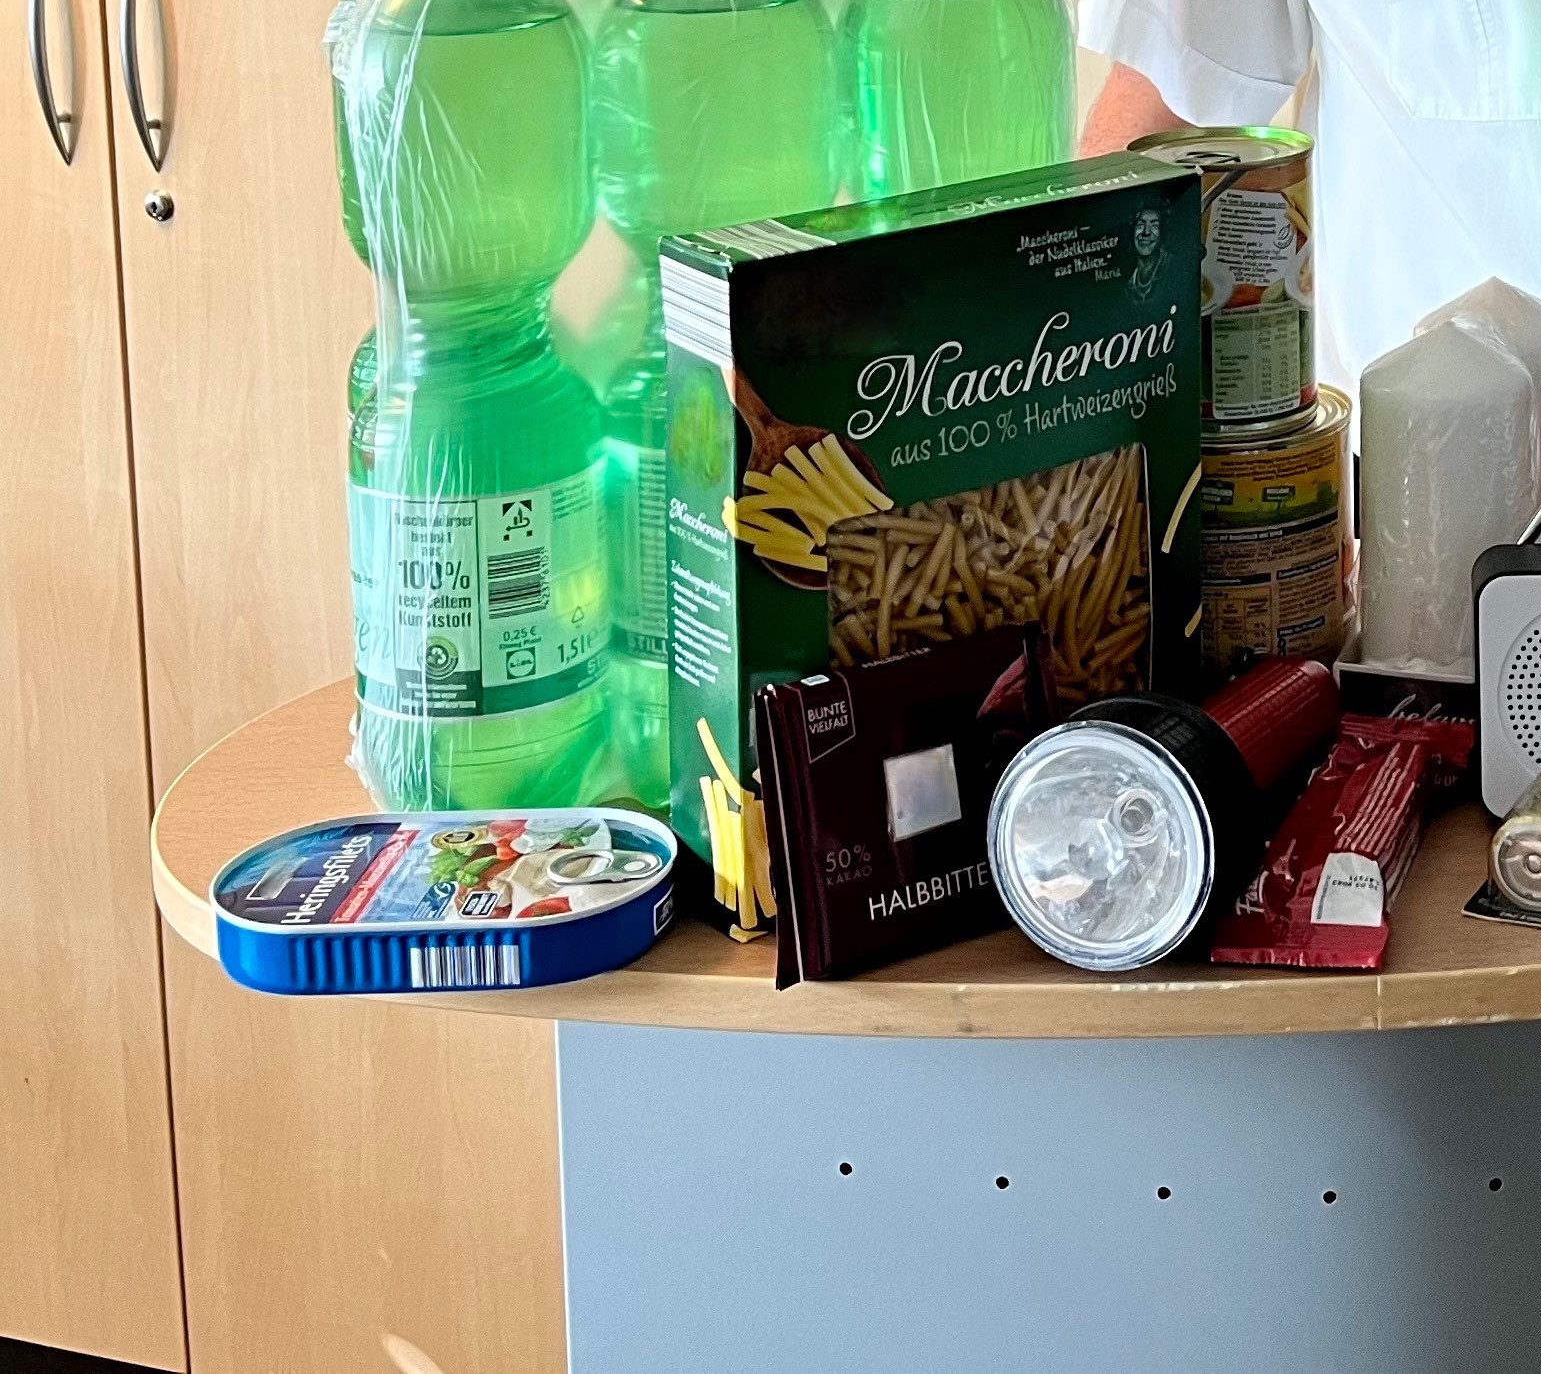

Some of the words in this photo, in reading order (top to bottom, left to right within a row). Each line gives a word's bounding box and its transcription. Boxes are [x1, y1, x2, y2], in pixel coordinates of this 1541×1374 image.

[1047, 235, 1119, 261] Nudelklassiker
[1054, 263, 1072, 278] aus
[1094, 268, 1122, 283] Maria
[847, 305, 1177, 440] Maccheroni
[890, 437, 932, 467] aus
[938, 420, 991, 457] 100
[996, 409, 1018, 444] %
[1023, 362, 1177, 434] Hartweizengrieß
[807, 700, 848, 723] BUNTE
[808, 715, 849, 734] VIELFALT
[280, 834, 373, 924] Heringsfilets
[826, 864, 873, 889] KAKAO
[868, 861, 990, 921] HALBBITTE
